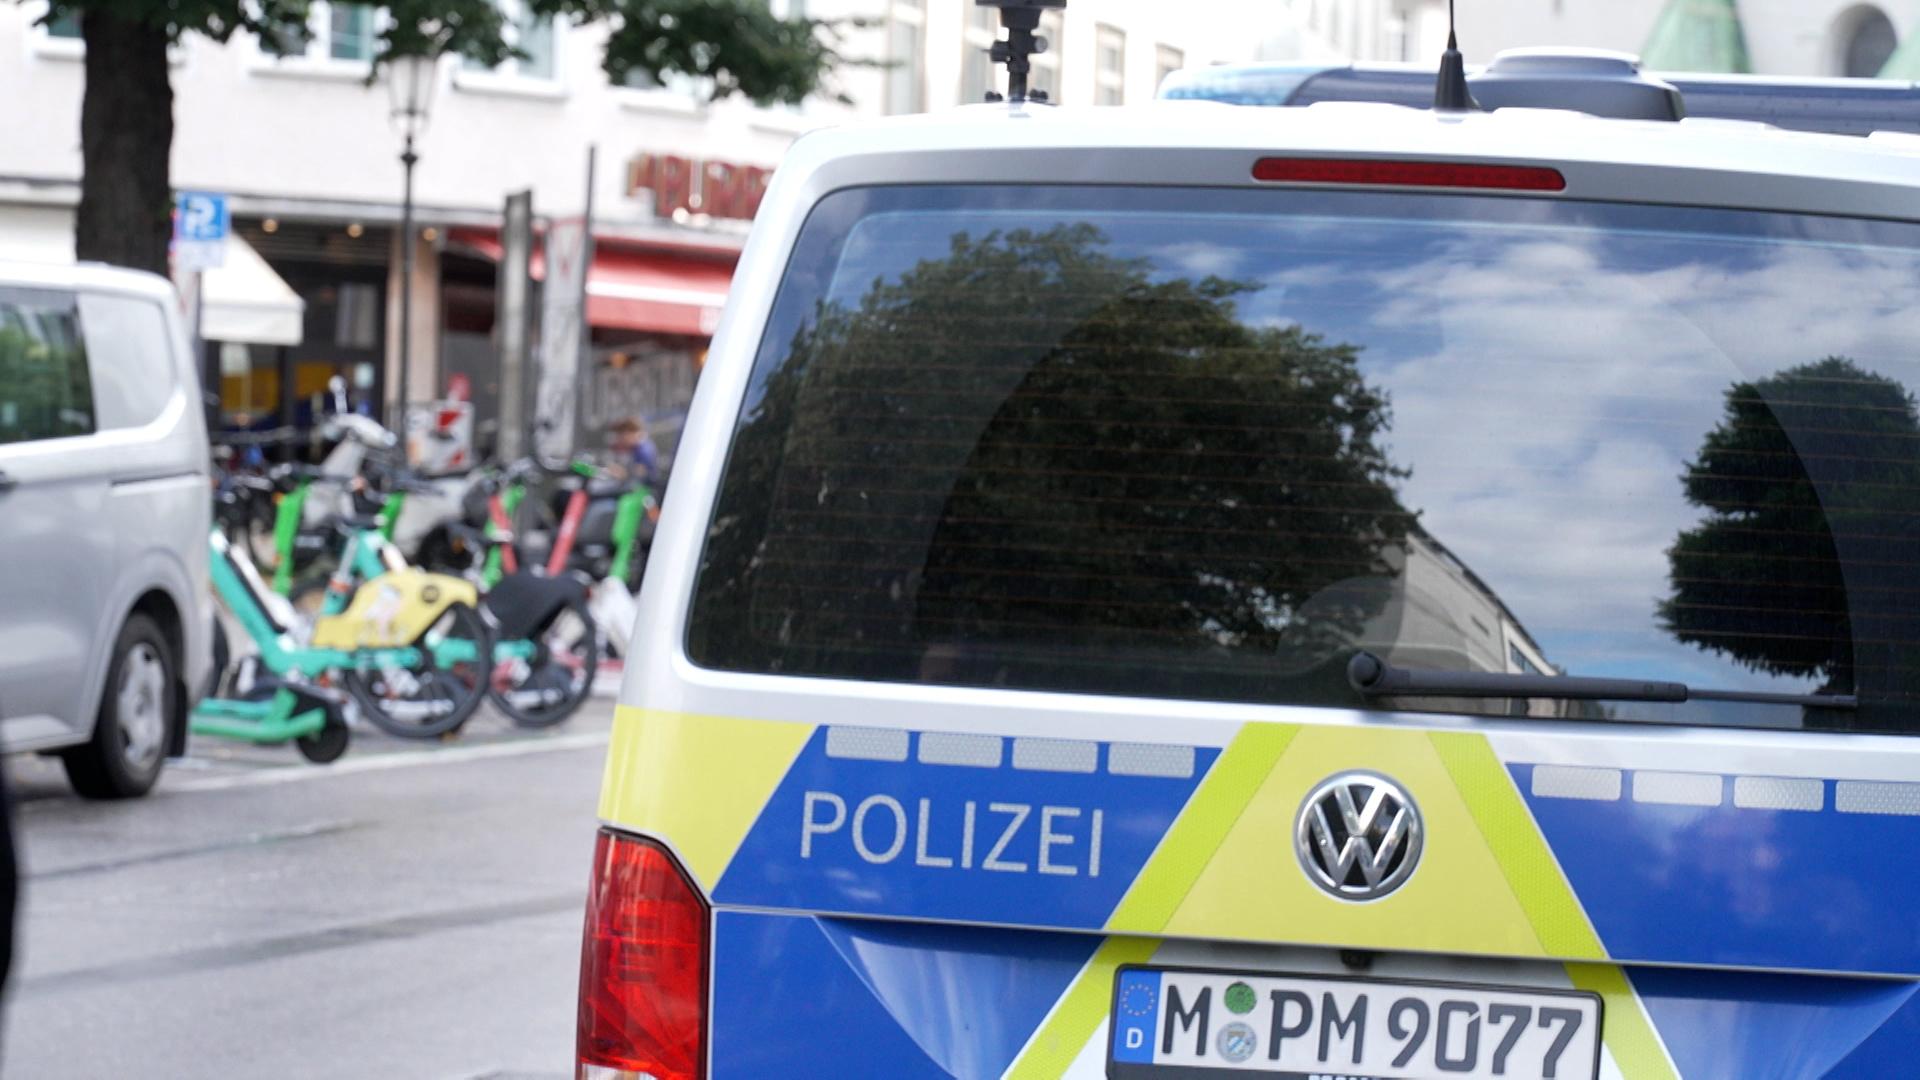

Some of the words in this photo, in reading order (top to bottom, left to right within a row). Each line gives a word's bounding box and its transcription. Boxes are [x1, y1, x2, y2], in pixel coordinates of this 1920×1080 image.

[800, 790, 1104, 878] POLIZEI
[1125, 1028, 1144, 1049] D
[1161, 984, 1212, 1057] M
[1268, 989, 1369, 1064] PM
[1387, 997, 1583, 1079] 9077
